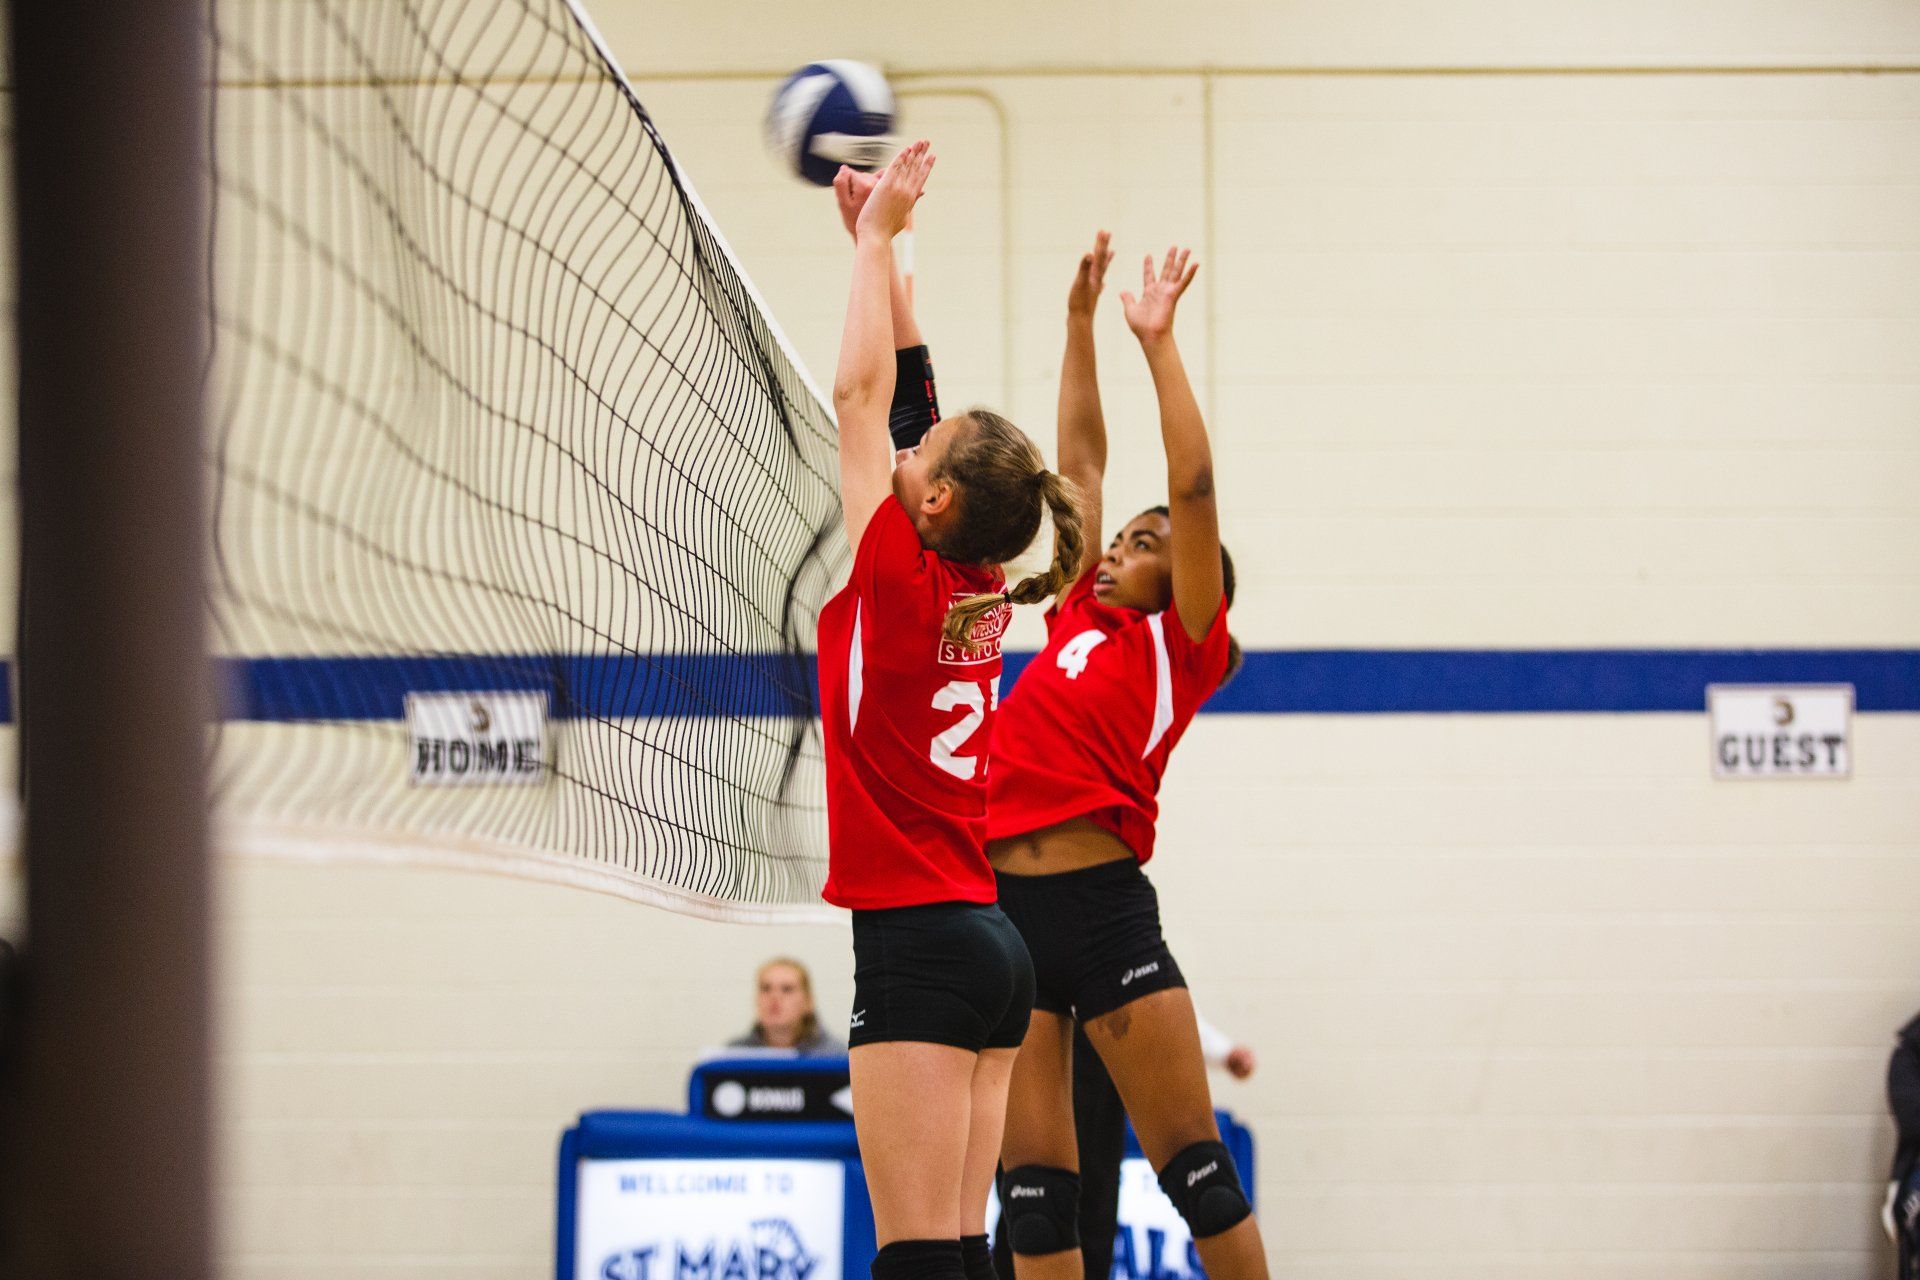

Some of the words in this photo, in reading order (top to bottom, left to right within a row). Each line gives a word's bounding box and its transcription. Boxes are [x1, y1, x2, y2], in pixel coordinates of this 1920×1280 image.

[1056, 629, 1107, 680] 4
[930, 675, 1001, 781] 2
[417, 738, 540, 774] HOME
[1719, 734, 1843, 768] GUEST
[619, 1174, 747, 1194] WELCOME
[764, 1174, 793, 1195] TO
